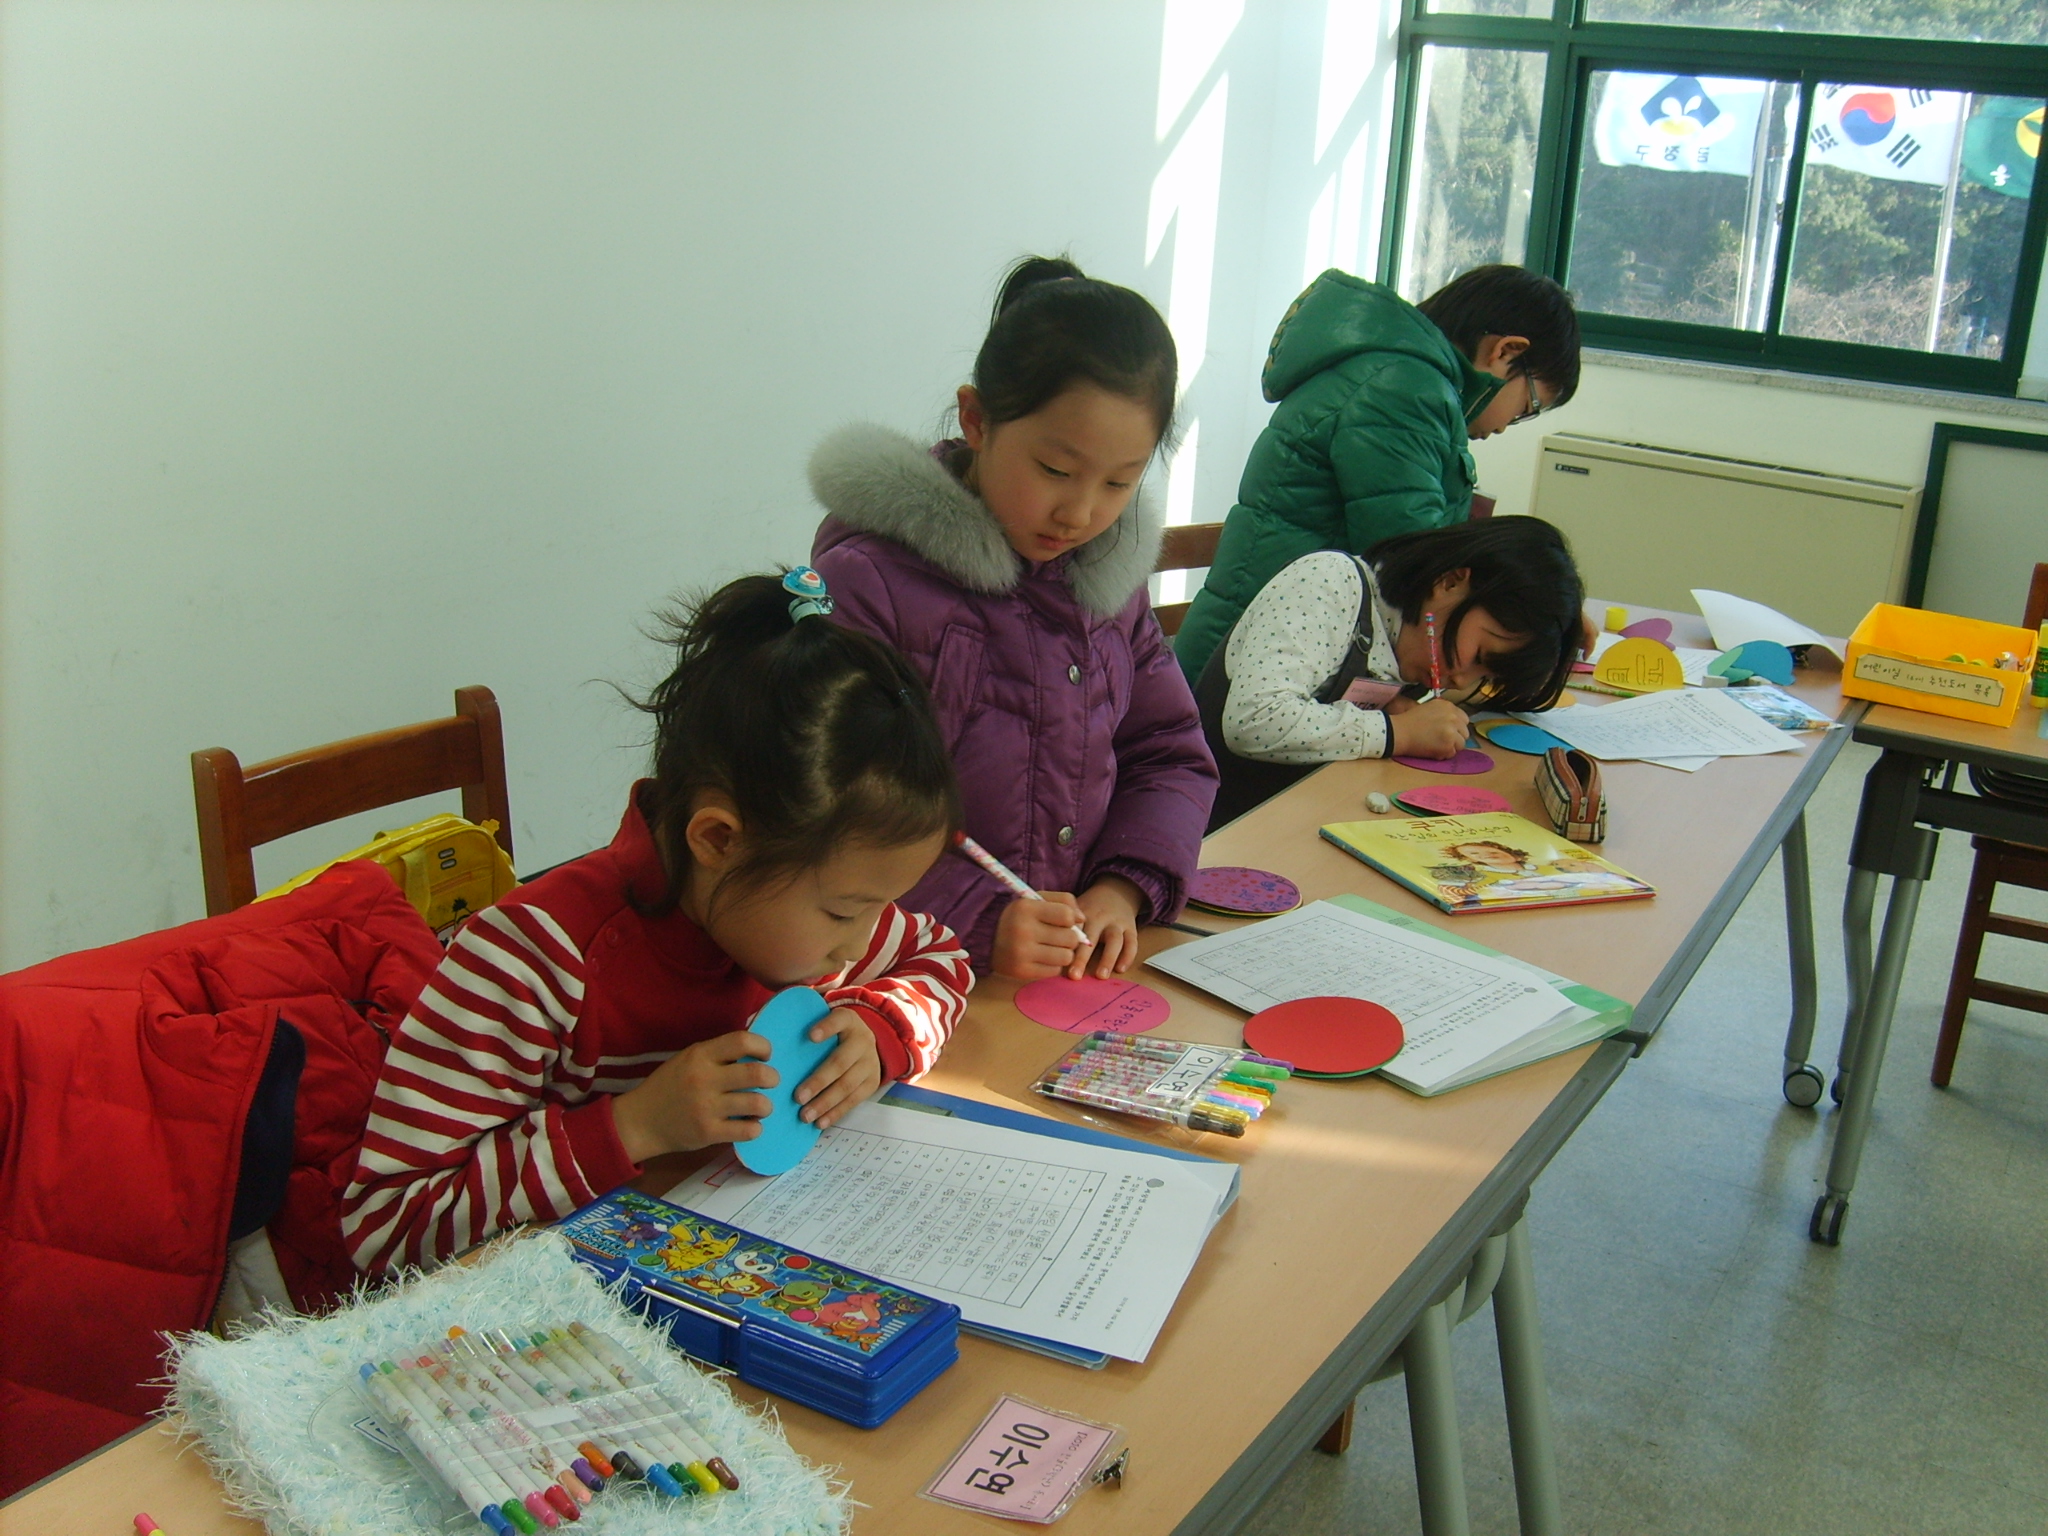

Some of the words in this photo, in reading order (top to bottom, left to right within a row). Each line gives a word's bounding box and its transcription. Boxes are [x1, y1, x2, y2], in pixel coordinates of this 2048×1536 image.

[1405, 818, 1461, 831] 쿠키
[1155, 1056, 1214, 1093] 이수연
[964, 1422, 1050, 1495] 이수연
